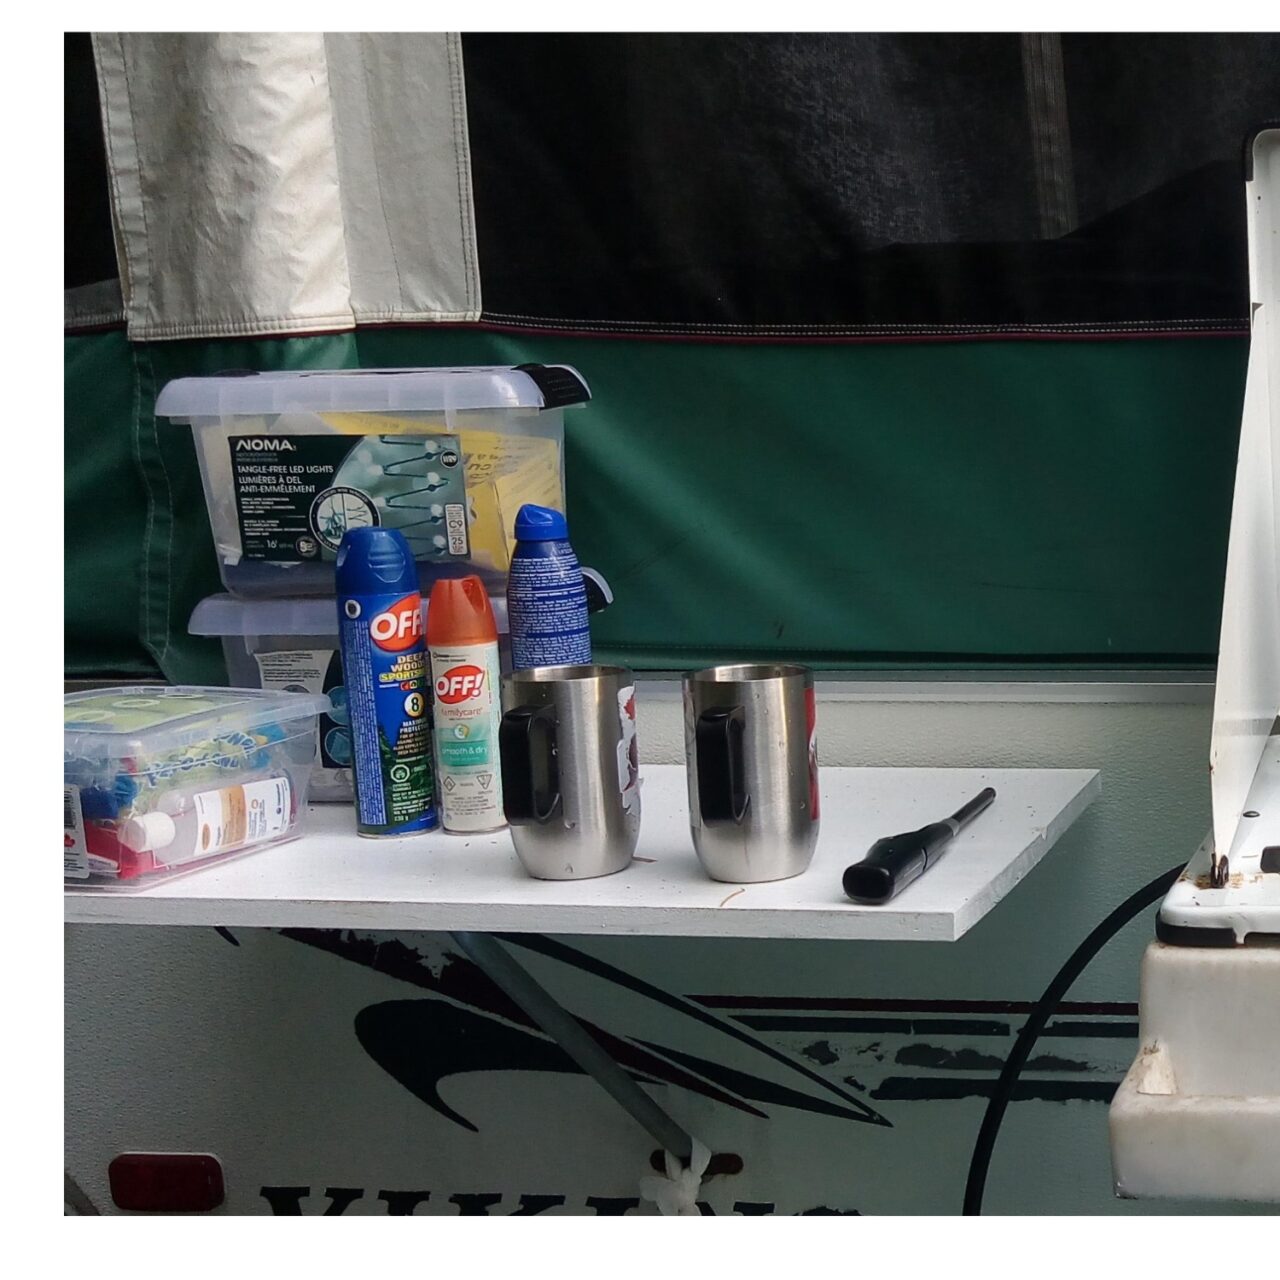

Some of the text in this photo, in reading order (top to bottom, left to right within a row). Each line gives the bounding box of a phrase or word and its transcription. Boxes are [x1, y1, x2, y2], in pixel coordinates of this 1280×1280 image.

[236, 439, 293, 451] NOMA
[238, 465, 334, 474] TANGLE-FREE LED LIGHTS
[239, 474, 277, 484] LUMIÈRES
[286, 475, 302, 484] DEL
[435, 672, 484, 697] OFF!
[411, 696, 420, 712] 8
